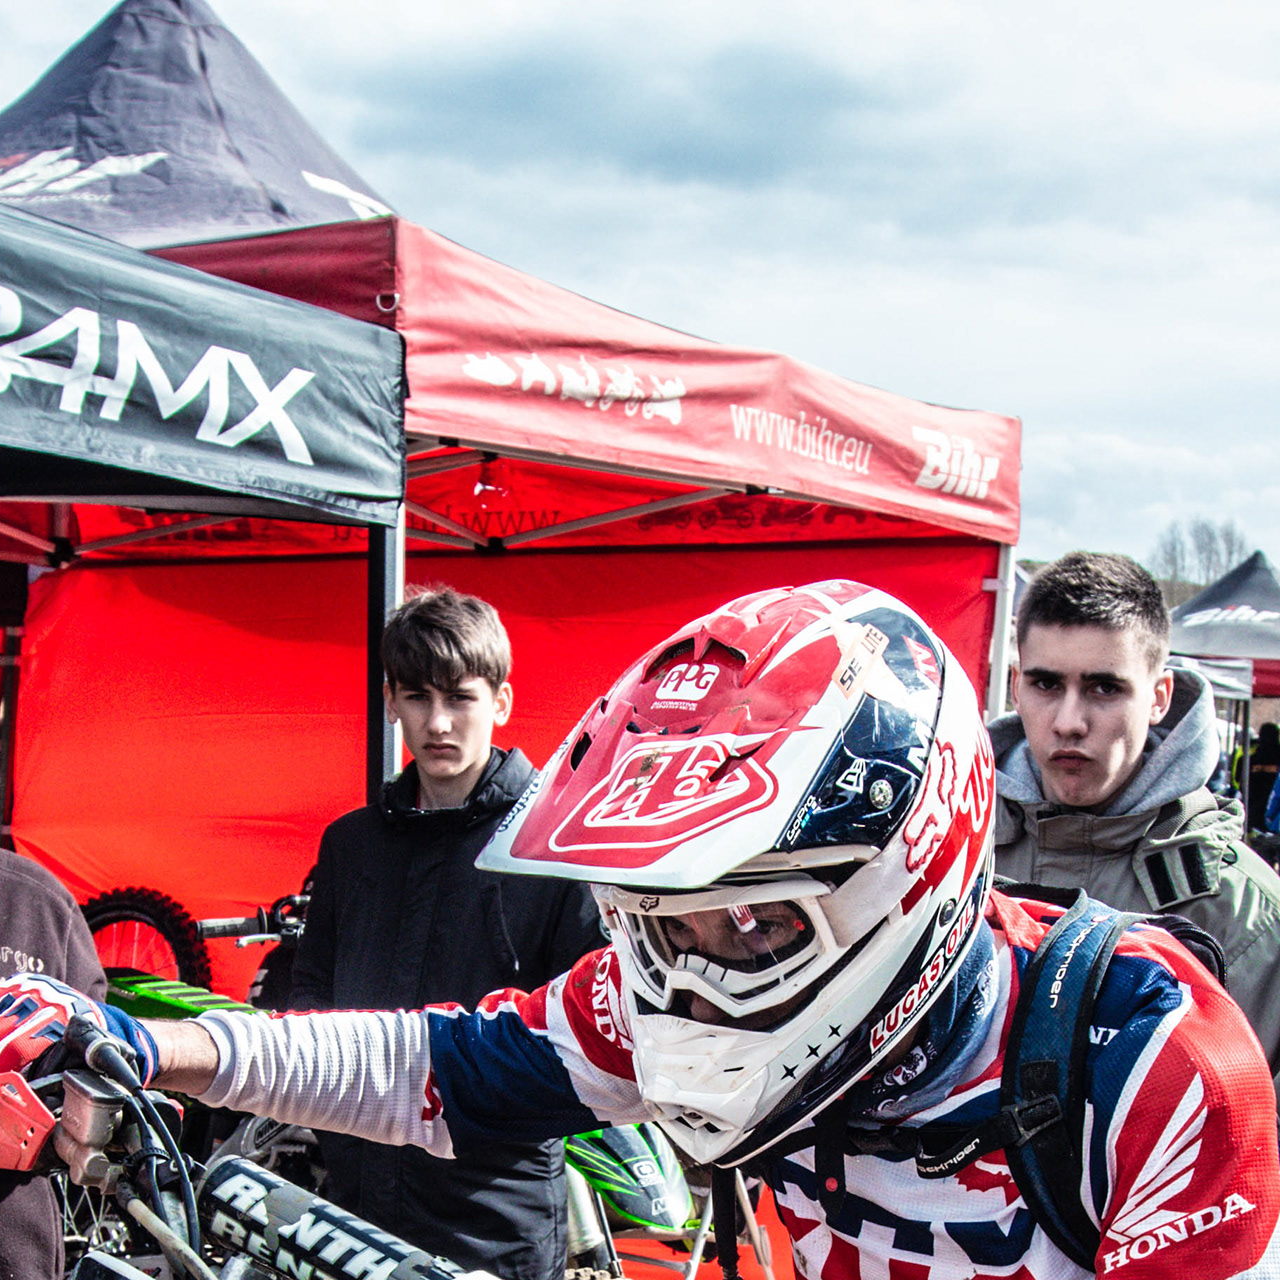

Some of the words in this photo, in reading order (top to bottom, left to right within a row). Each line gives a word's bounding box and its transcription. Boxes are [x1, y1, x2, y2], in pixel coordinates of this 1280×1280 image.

[730, 404, 873, 475] www.bihr.eu
[912, 425, 1000, 499] Bihr
[786, 794, 817, 842] GoPro
[871, 953, 943, 1051] LUCAS
[946, 904, 974, 956] OIL
[1103, 1192, 1256, 1274] HONDA
